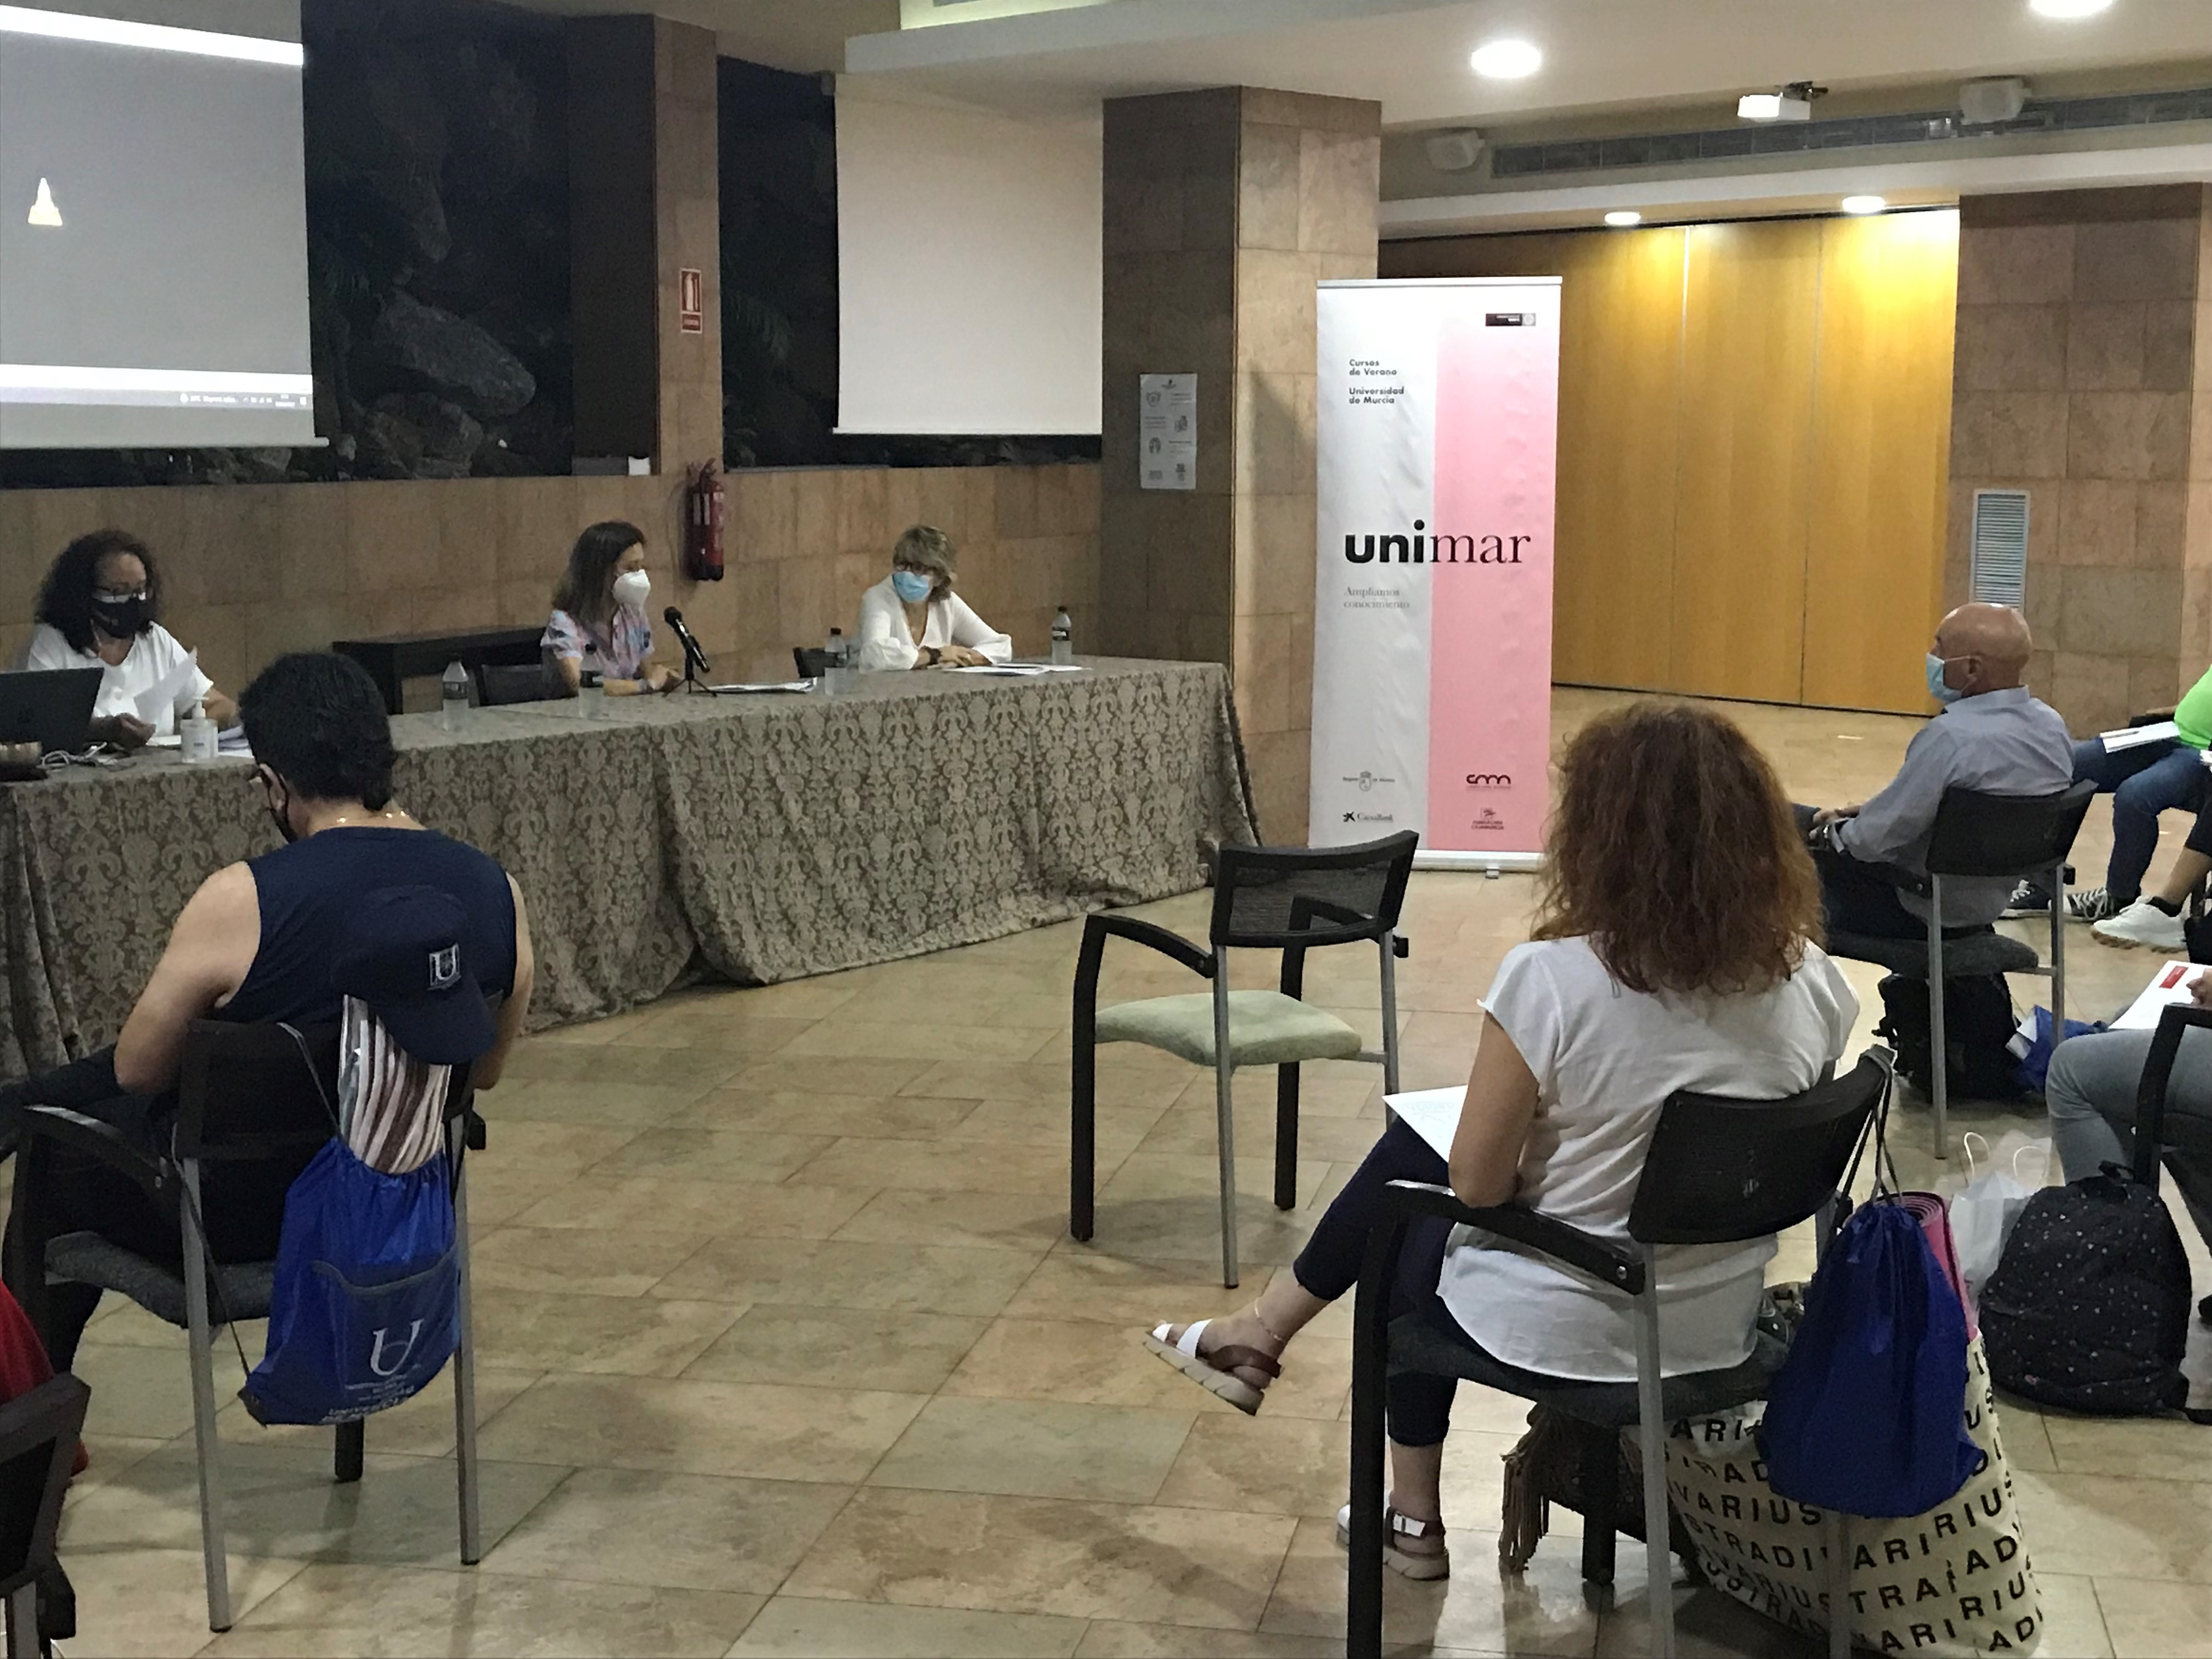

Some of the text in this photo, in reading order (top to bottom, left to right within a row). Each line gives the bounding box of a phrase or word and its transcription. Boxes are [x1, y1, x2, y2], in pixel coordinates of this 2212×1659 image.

[1349, 368, 1397, 376] de Verano
[1349, 386, 1404, 394] Universidad
[1363, 396, 1395, 404] Murcia
[1345, 519, 1531, 564] unimar
[370, 1318, 424, 1376] U
